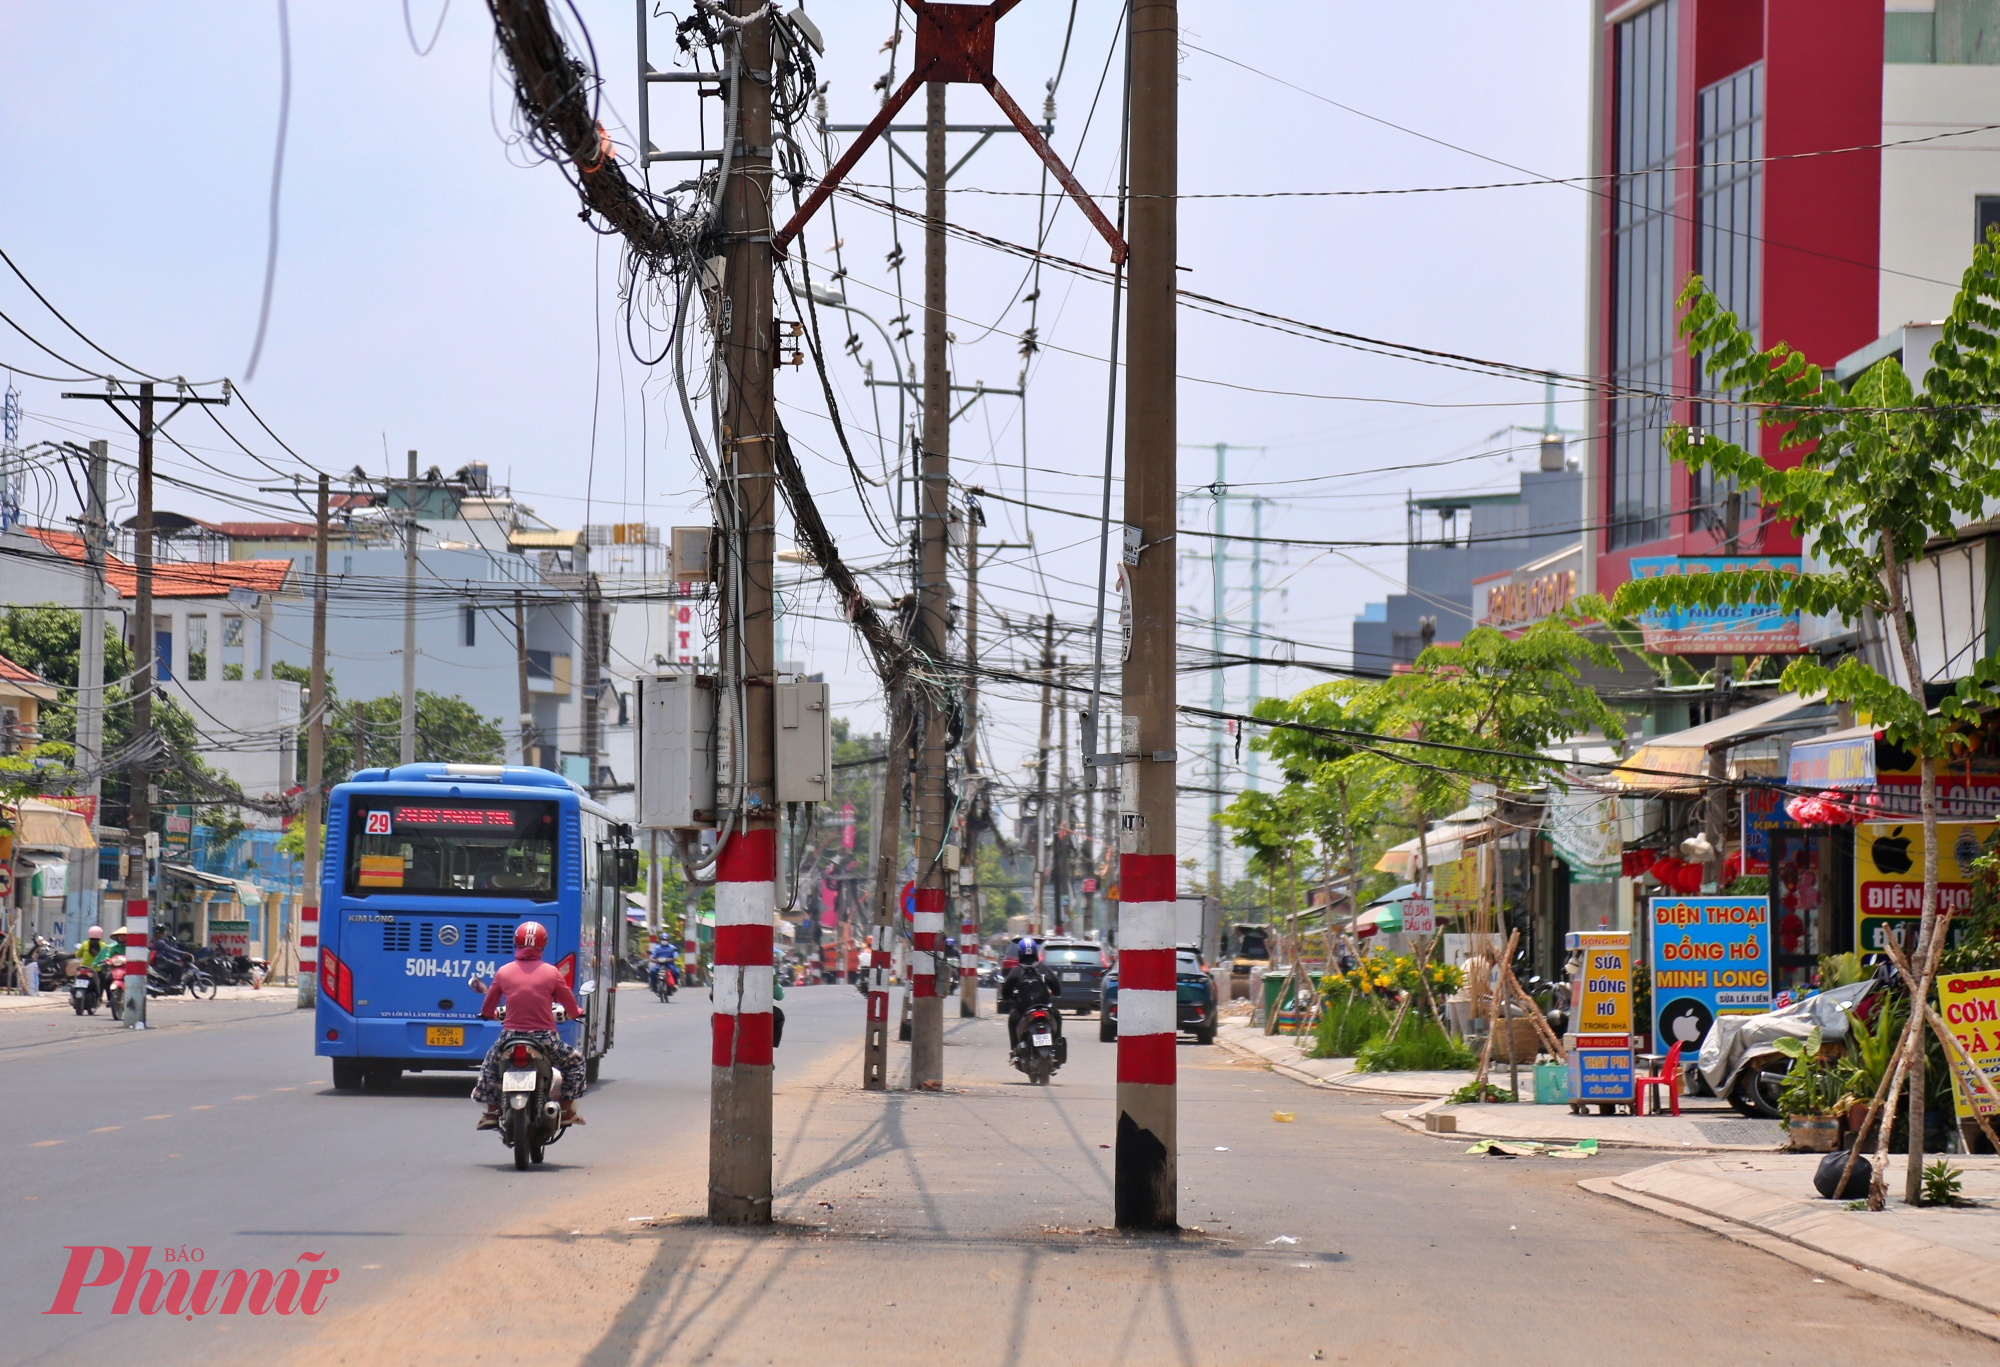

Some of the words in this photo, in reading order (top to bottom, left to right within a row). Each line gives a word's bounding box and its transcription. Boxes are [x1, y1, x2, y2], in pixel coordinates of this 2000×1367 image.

[1935, 785, 2000, 816] LONG
[369, 813, 389, 833] 29
[1868, 884, 1921, 913] ĐIỆN
[349, 915, 367, 923] KIM
[369, 915, 394, 923] LONG
[1655, 902, 1701, 929] ĐIỆN
[1705, 906, 1766, 929] THOẠI
[1663, 934, 1725, 961] ĐỒNG
[1729, 933, 1762, 961] HỒ
[1595, 952, 1622, 970] SỬA
[1656, 969, 1708, 989] MINH
[1713, 969, 1768, 989] LONG
[1947, 997, 1998, 1025] CƠM
[436, 1028, 453, 1036] 50H
[1584, 1022, 1609, 1030] TRONG
[1580, 1038, 1592, 1046] PIN
[1594, 1038, 1625, 1046] REMOTE
[1584, 1056, 1609, 1070] THAY
[1611, 1056, 1629, 1069] PIN
